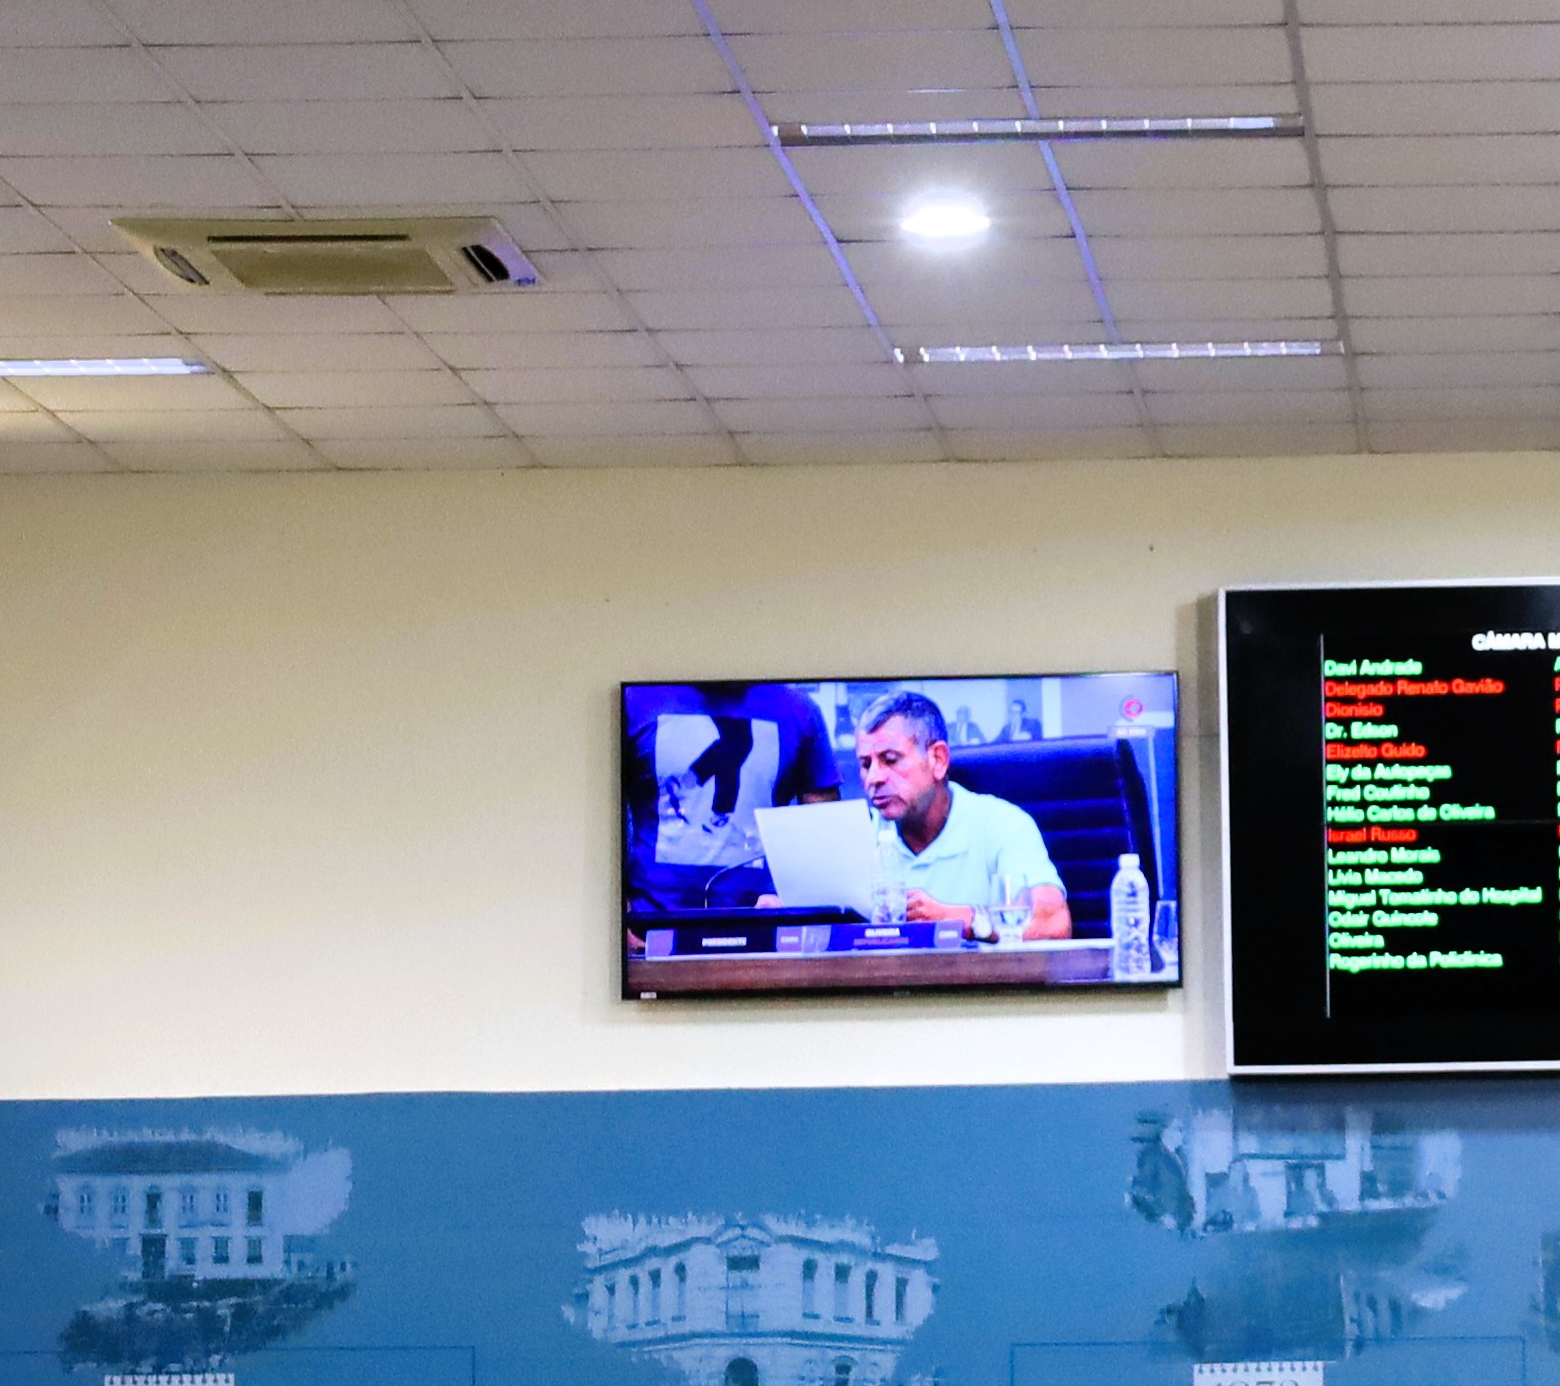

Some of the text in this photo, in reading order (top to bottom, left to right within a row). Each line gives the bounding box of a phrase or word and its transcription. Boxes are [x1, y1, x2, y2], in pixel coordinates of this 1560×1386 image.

[1472, 628, 1546, 651] CÂMARA
[1360, 659, 1422, 675] Andrade
[1325, 677, 1505, 699] Delegado Renato Gavião
[1325, 721, 1398, 740] Dr. Edson
[1381, 742, 1427, 759] Guido
[1326, 764, 1350, 784] Ely
[1363, 784, 1430, 801] Coutinho
[1367, 805, 1415, 822] Carlos
[1439, 803, 1496, 820] Oliveira
[1327, 825, 1418, 843] Israel Russo
[1328, 847, 1389, 865] Leandro
[1482, 886, 1542, 906] Hospital
[1328, 931, 1385, 949] Oliveira
